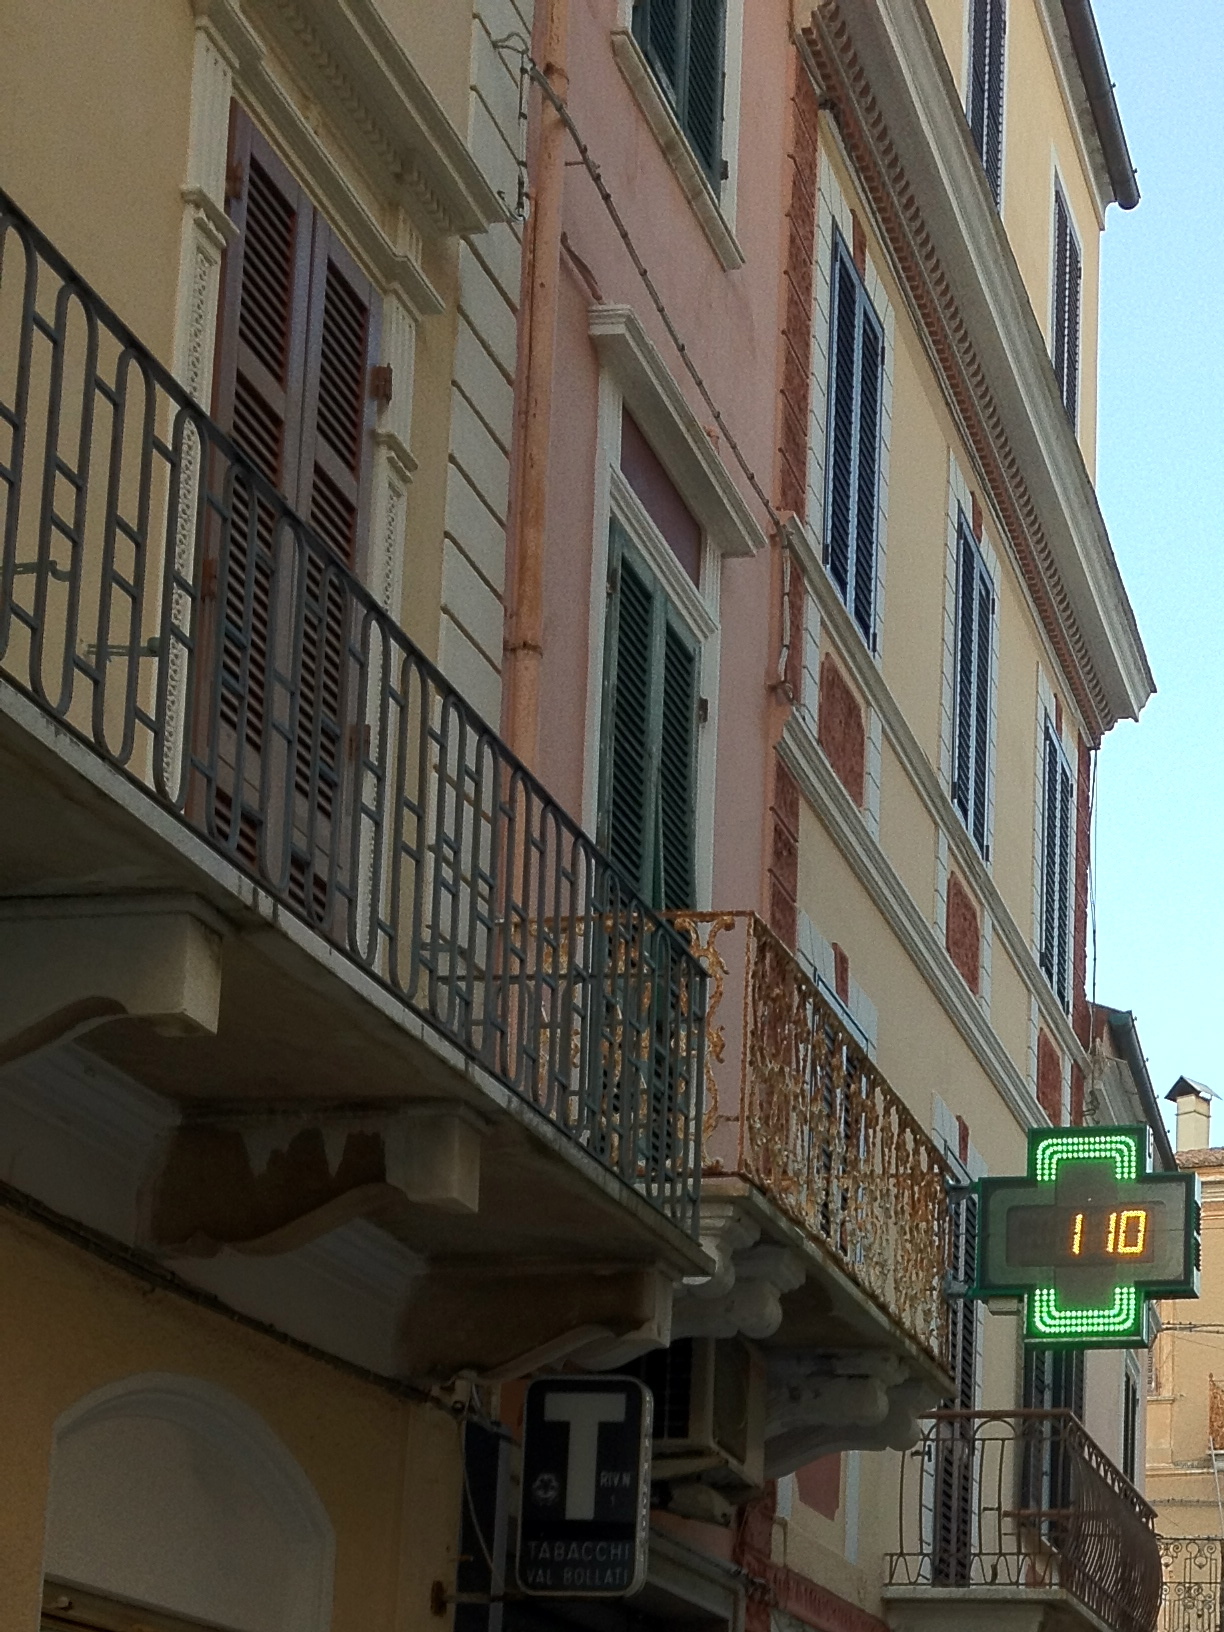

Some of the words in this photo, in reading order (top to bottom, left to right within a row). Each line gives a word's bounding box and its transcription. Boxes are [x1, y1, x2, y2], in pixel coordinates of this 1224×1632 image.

[544, 1392, 626, 1520] T
[527, 1540, 631, 1562] TABACCHI
[526, 1567, 553, 1586] VAL
[563, 1566, 629, 1586] BOLLATI
